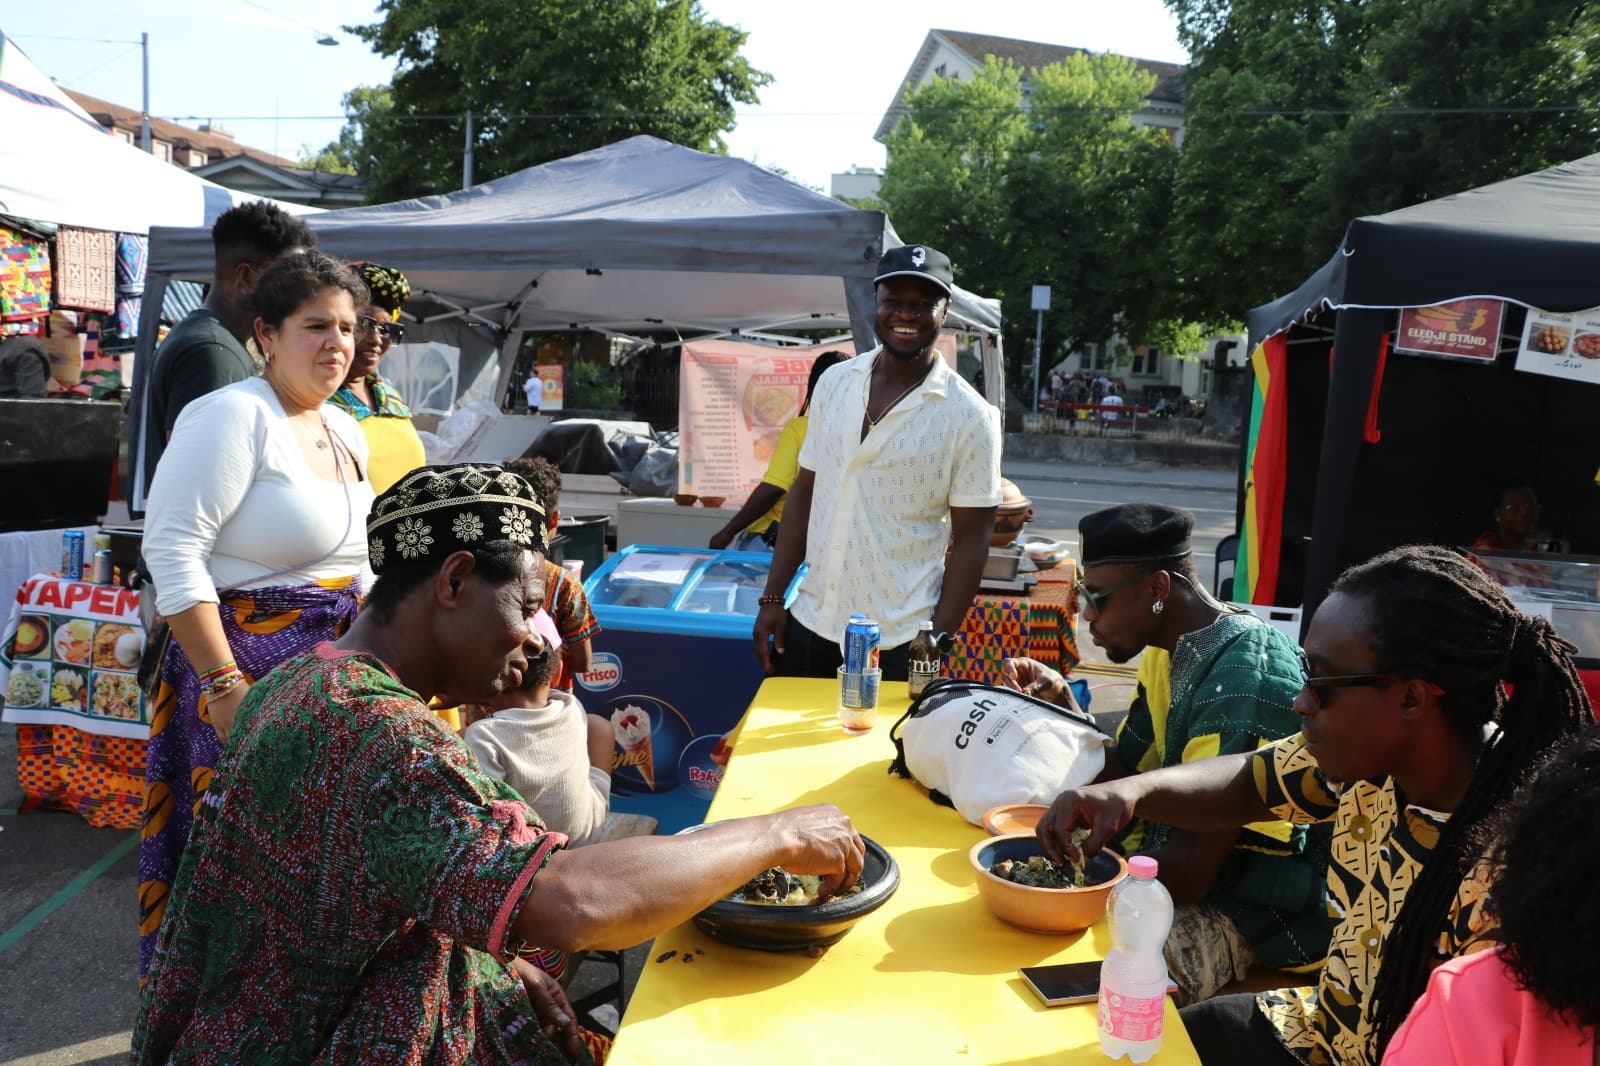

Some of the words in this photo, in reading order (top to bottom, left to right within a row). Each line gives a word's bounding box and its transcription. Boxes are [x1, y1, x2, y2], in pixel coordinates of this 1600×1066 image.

[1408, 327, 1446, 341] ELEDJI
[1449, 332, 1487, 346] STAND
[582, 668, 617, 682] Frisco
[955, 698, 997, 750] cash
